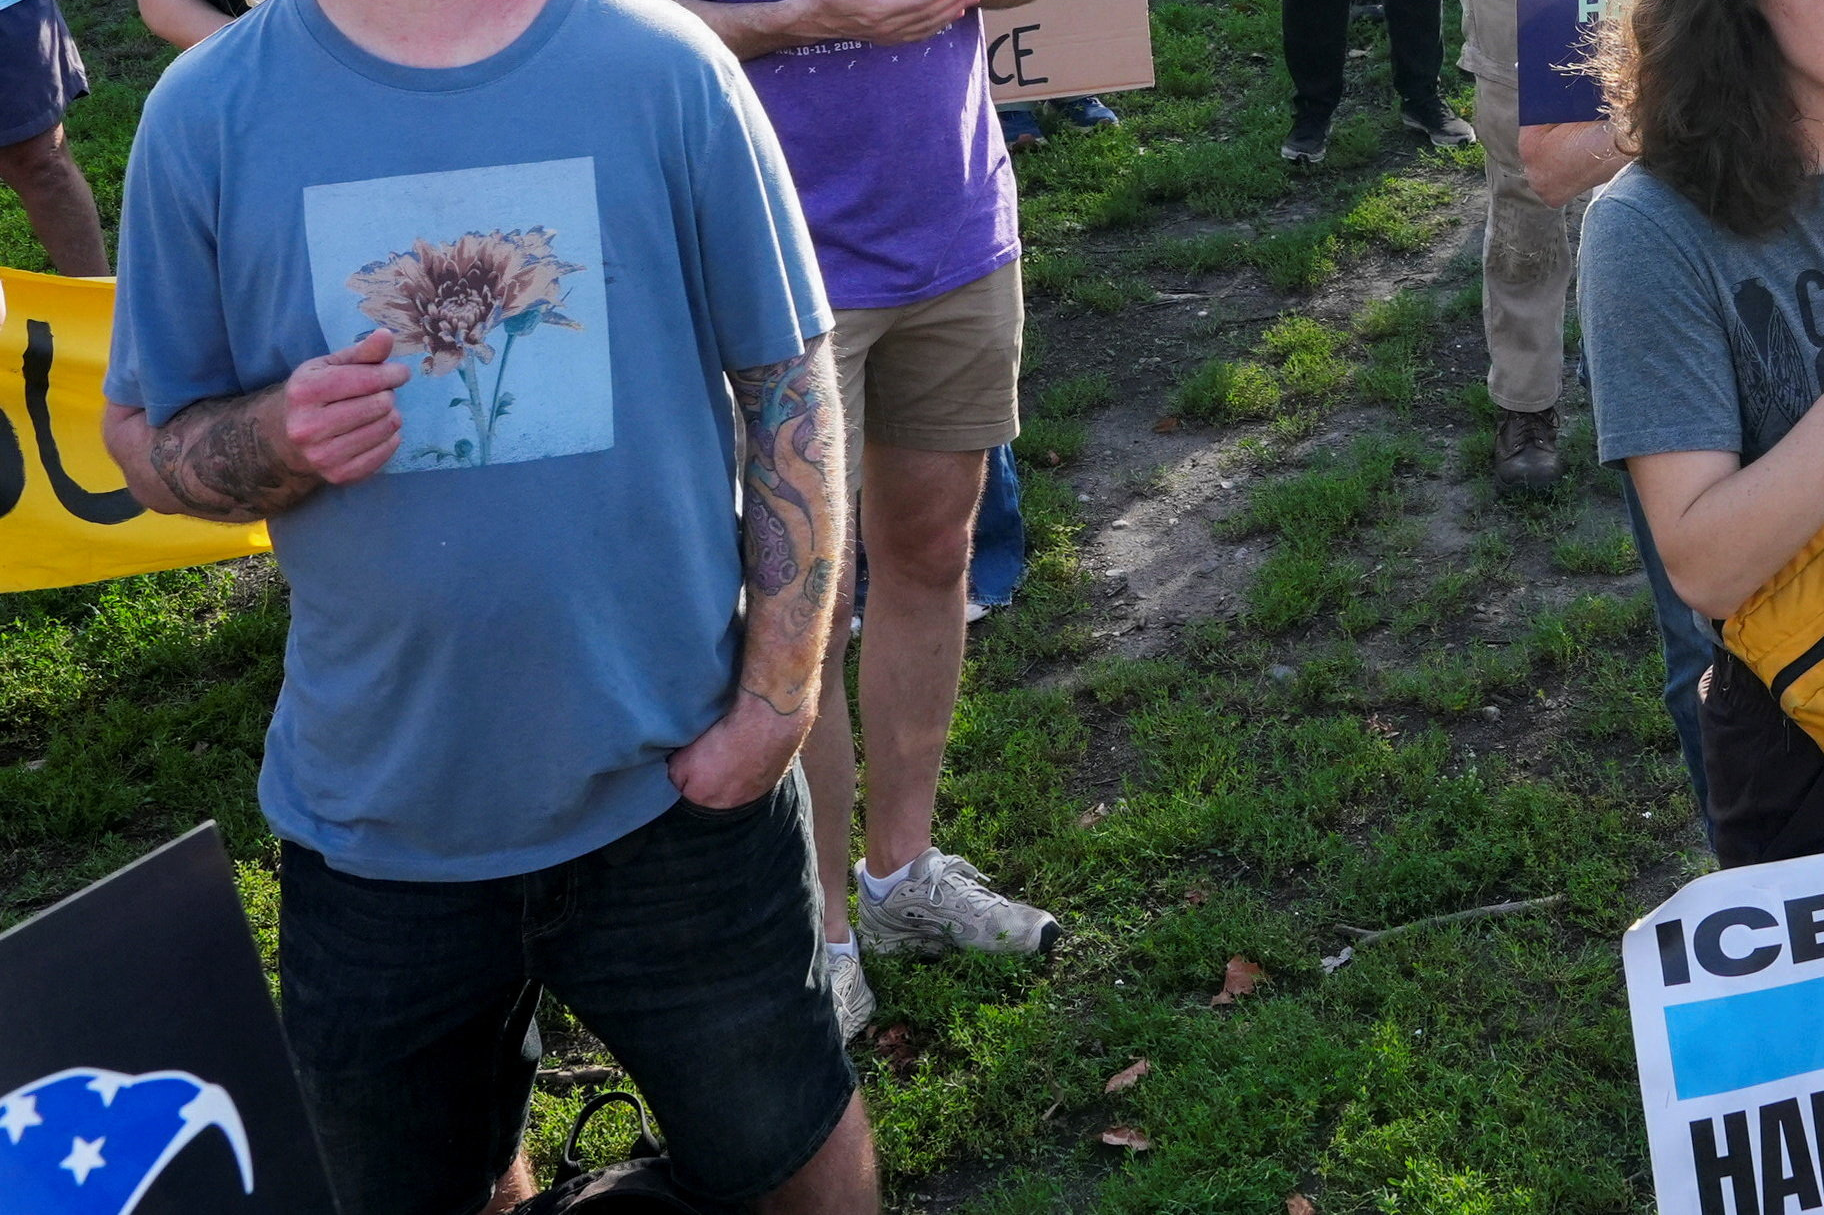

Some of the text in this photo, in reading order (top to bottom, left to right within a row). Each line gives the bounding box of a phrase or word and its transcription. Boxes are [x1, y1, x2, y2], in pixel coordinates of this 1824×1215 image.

[796, 43, 832, 57] 10-11,
[834, 39, 863, 52] 2018
[987, 23, 1049, 87] CE
